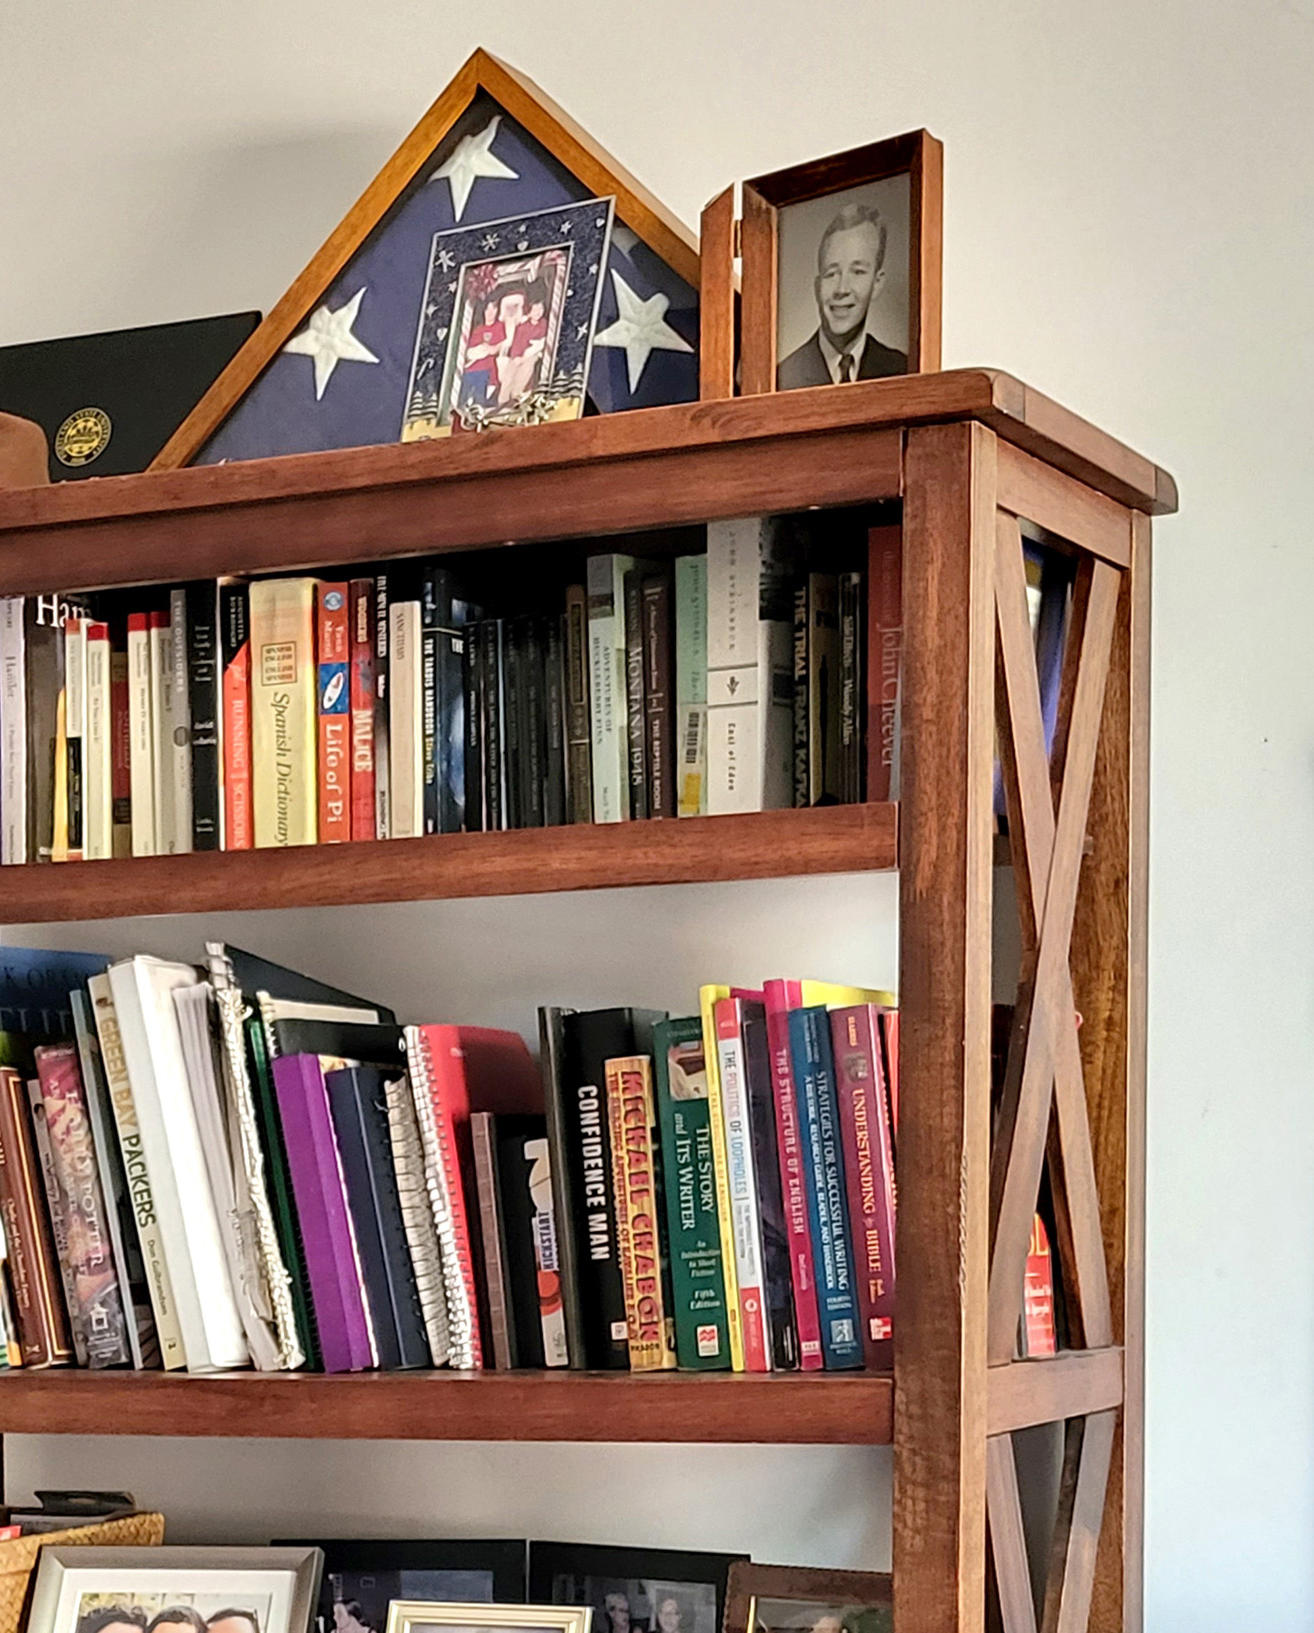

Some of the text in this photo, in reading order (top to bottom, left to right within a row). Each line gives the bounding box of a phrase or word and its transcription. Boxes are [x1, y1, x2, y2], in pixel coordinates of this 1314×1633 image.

[794, 586, 805, 625] THE
[174, 626, 185, 692] OUTSIDERS
[324, 620, 333, 659] Martel
[424, 638, 434, 656] THE
[794, 629, 806, 680] TRIAL
[876, 622, 901, 681] John
[424, 657, 434, 687] TARDIS
[603, 645, 612, 716] ADVENTURES
[352, 709, 373, 772] MALICE
[628, 646, 644, 787] MONTANA 1948
[727, 723, 737, 745] East
[795, 685, 807, 743] FRANZ
[232, 700, 246, 849] RUNNING SCISSORS
[271, 691, 292, 846] Spanish Dictionary
[325, 723, 343, 823] Life of Pi
[651, 718, 662, 810] THE REPTILE ROOM
[727, 766, 736, 791] Eden
[724, 1051, 736, 1070] THE
[100, 1016, 158, 1229] GREEN BAY PACKERS
[725, 1070, 740, 1118] POLITICS
[816, 1070, 833, 1140] STRATEGIES
[577, 1084, 611, 1262] CONFIDENCE MAN
[673, 1113, 697, 1232] and ITS WRITER
[695, 1123, 715, 1215] THE STORY
[731, 1134, 748, 1195] LOOPHOLES
[776, 1047, 806, 1236] THE STRUCTURE OF ENGLISH
[822, 1139, 836, 1165] FOR
[621, 1070, 660, 1342] MICHAEL CHABON
[825, 1164, 845, 1238] SUCCESSFUL
[851, 1088, 878, 1215] UNDERSTANDING
[865, 1229, 882, 1273] BIBLE
[81, 1183, 105, 1270] POTTER
[541, 1210, 555, 1271] KICKSTART
[693, 1289, 716, 1300] Fifth
[831, 1239, 849, 1292] WRITING
[690, 1300, 721, 1311] Edition
